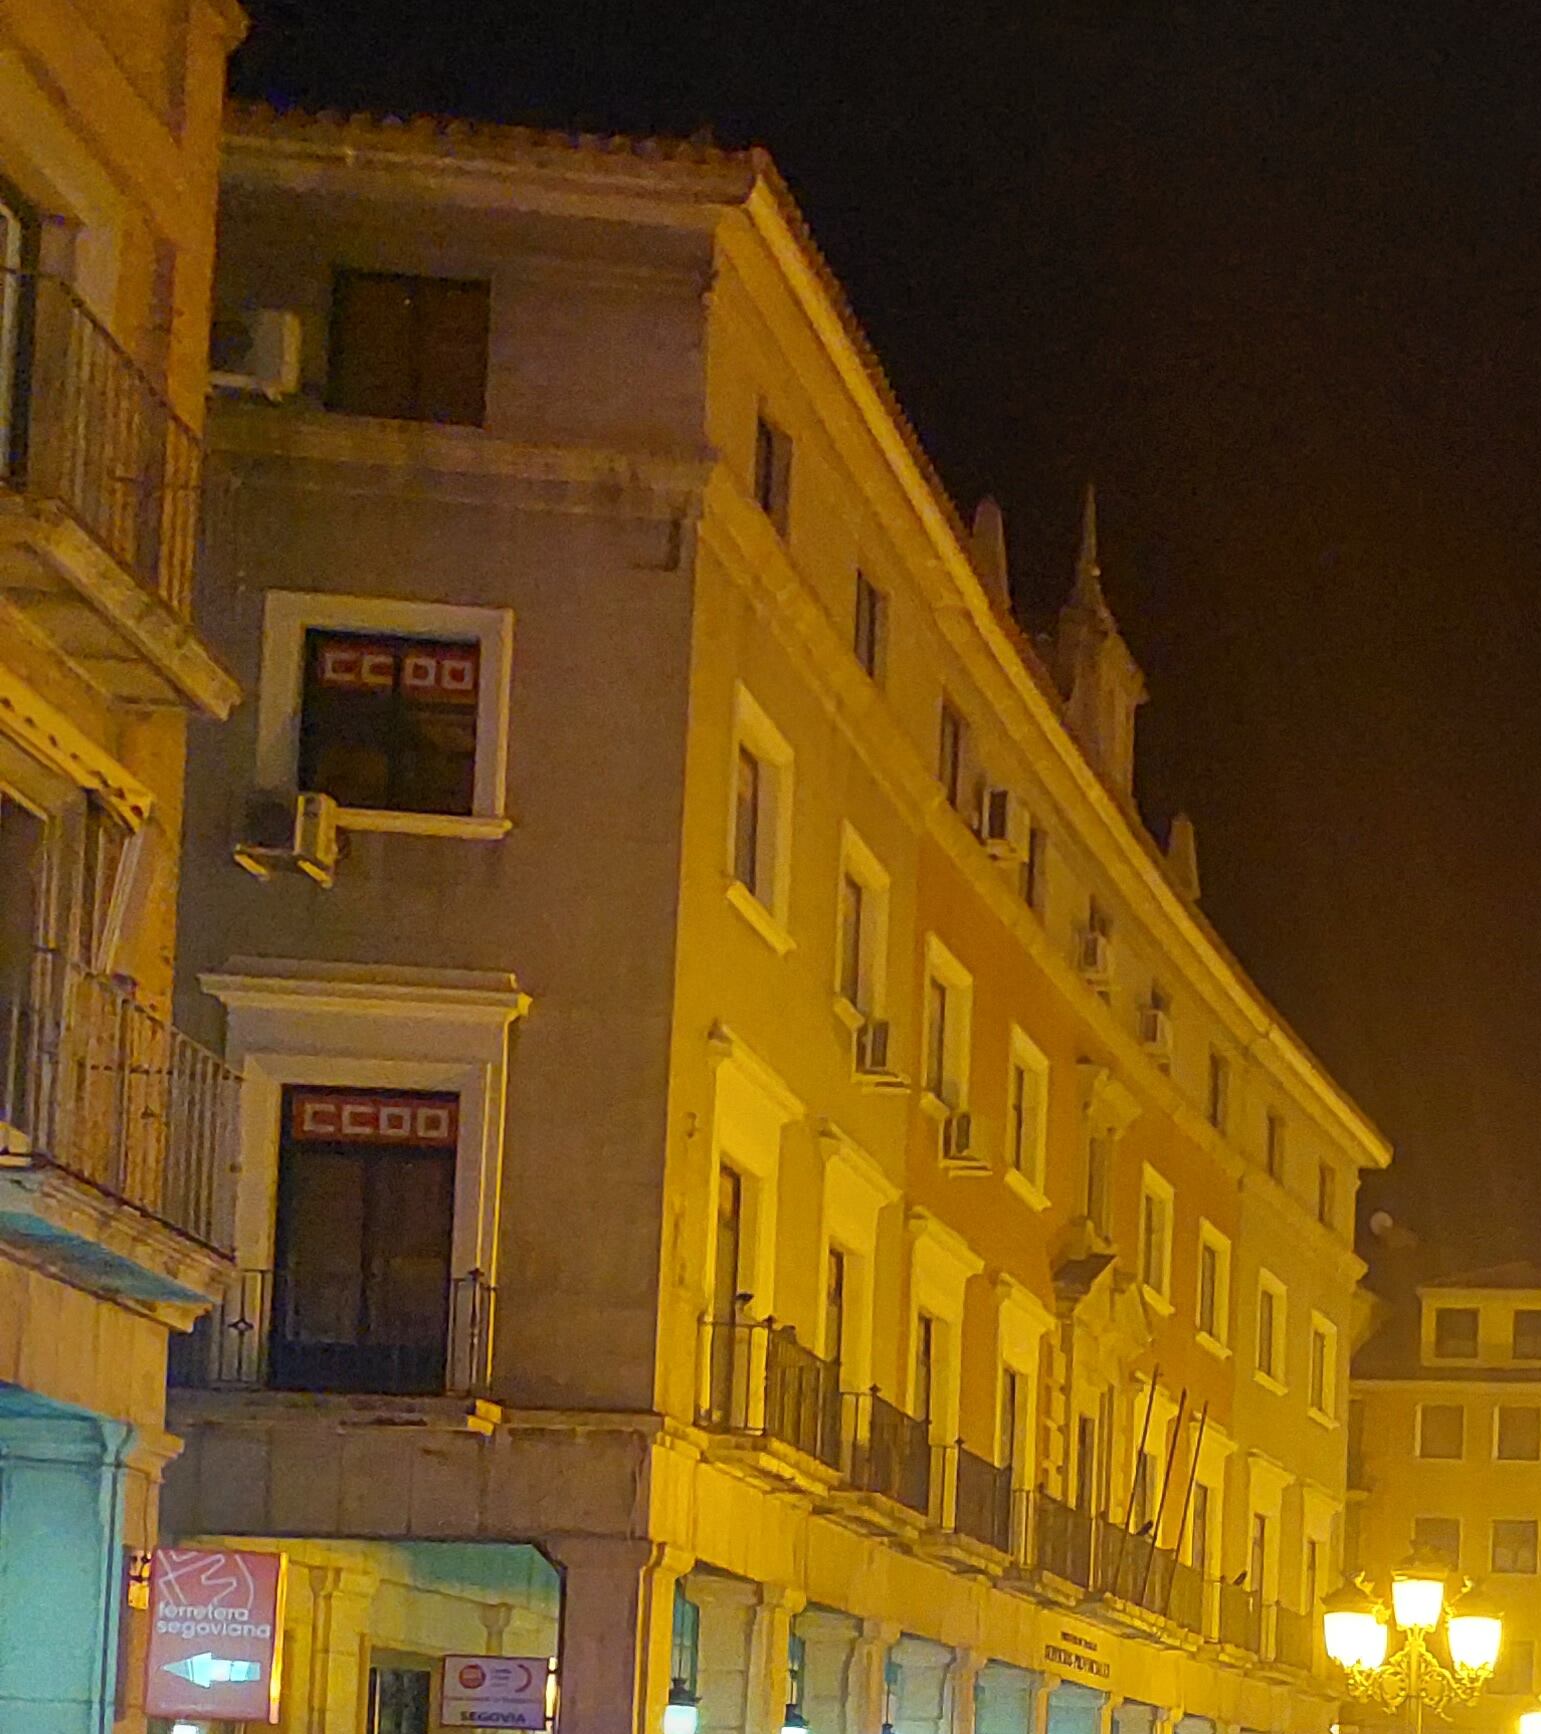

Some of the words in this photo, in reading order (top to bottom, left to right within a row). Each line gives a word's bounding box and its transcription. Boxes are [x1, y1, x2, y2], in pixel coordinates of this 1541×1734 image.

[322, 652, 473, 691] CCOO
[303, 1103, 450, 1139] CCOO
[156, 1619, 272, 1640] segoviana
[460, 1710, 526, 1724] SEGOVIA
